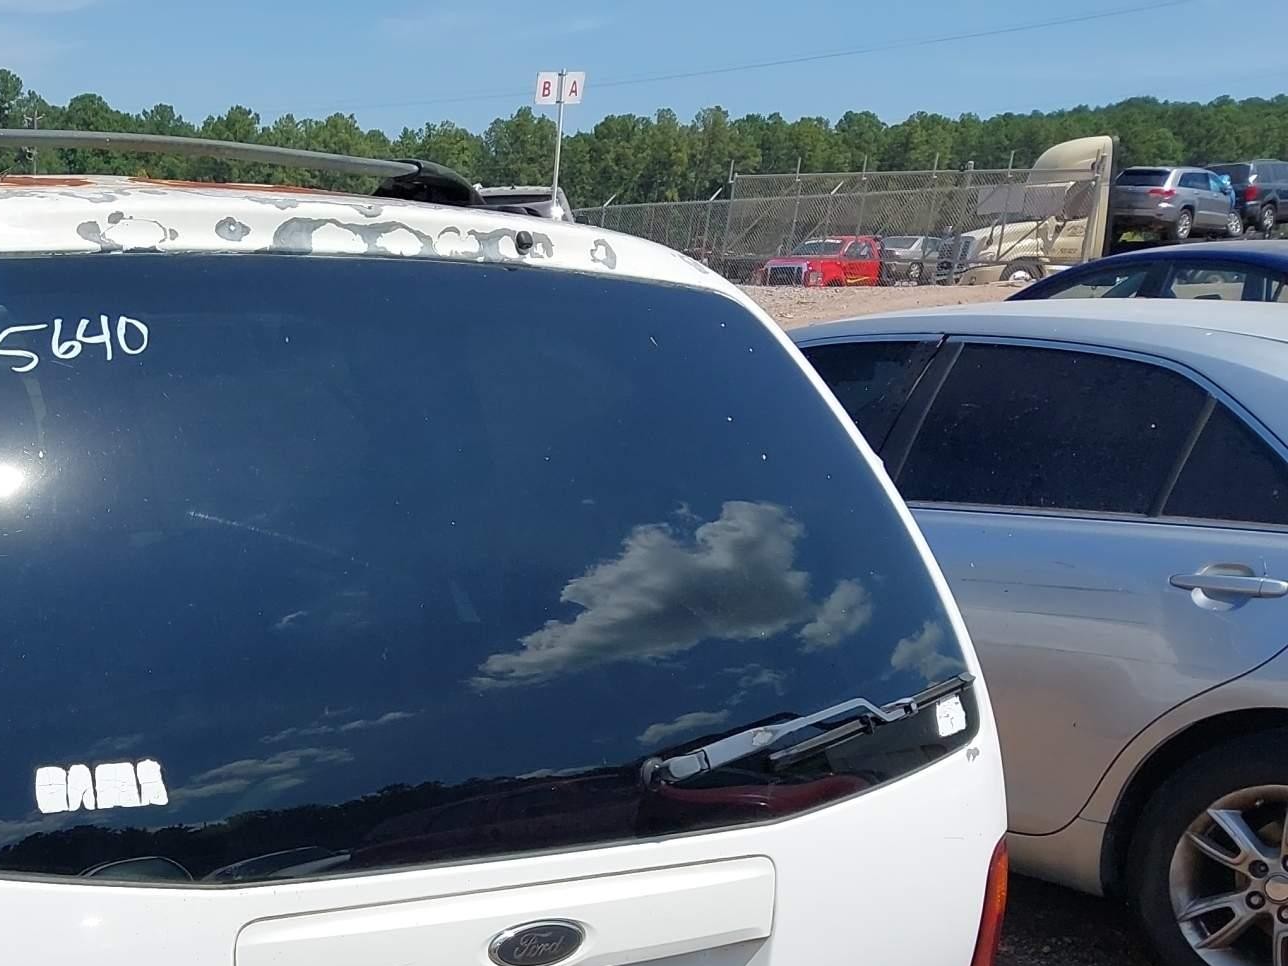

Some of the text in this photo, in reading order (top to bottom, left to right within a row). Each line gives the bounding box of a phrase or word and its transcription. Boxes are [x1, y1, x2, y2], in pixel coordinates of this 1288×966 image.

[541, 80, 552, 98] B
[568, 80, 579, 97] A
[513, 931, 565, 959] Ford
